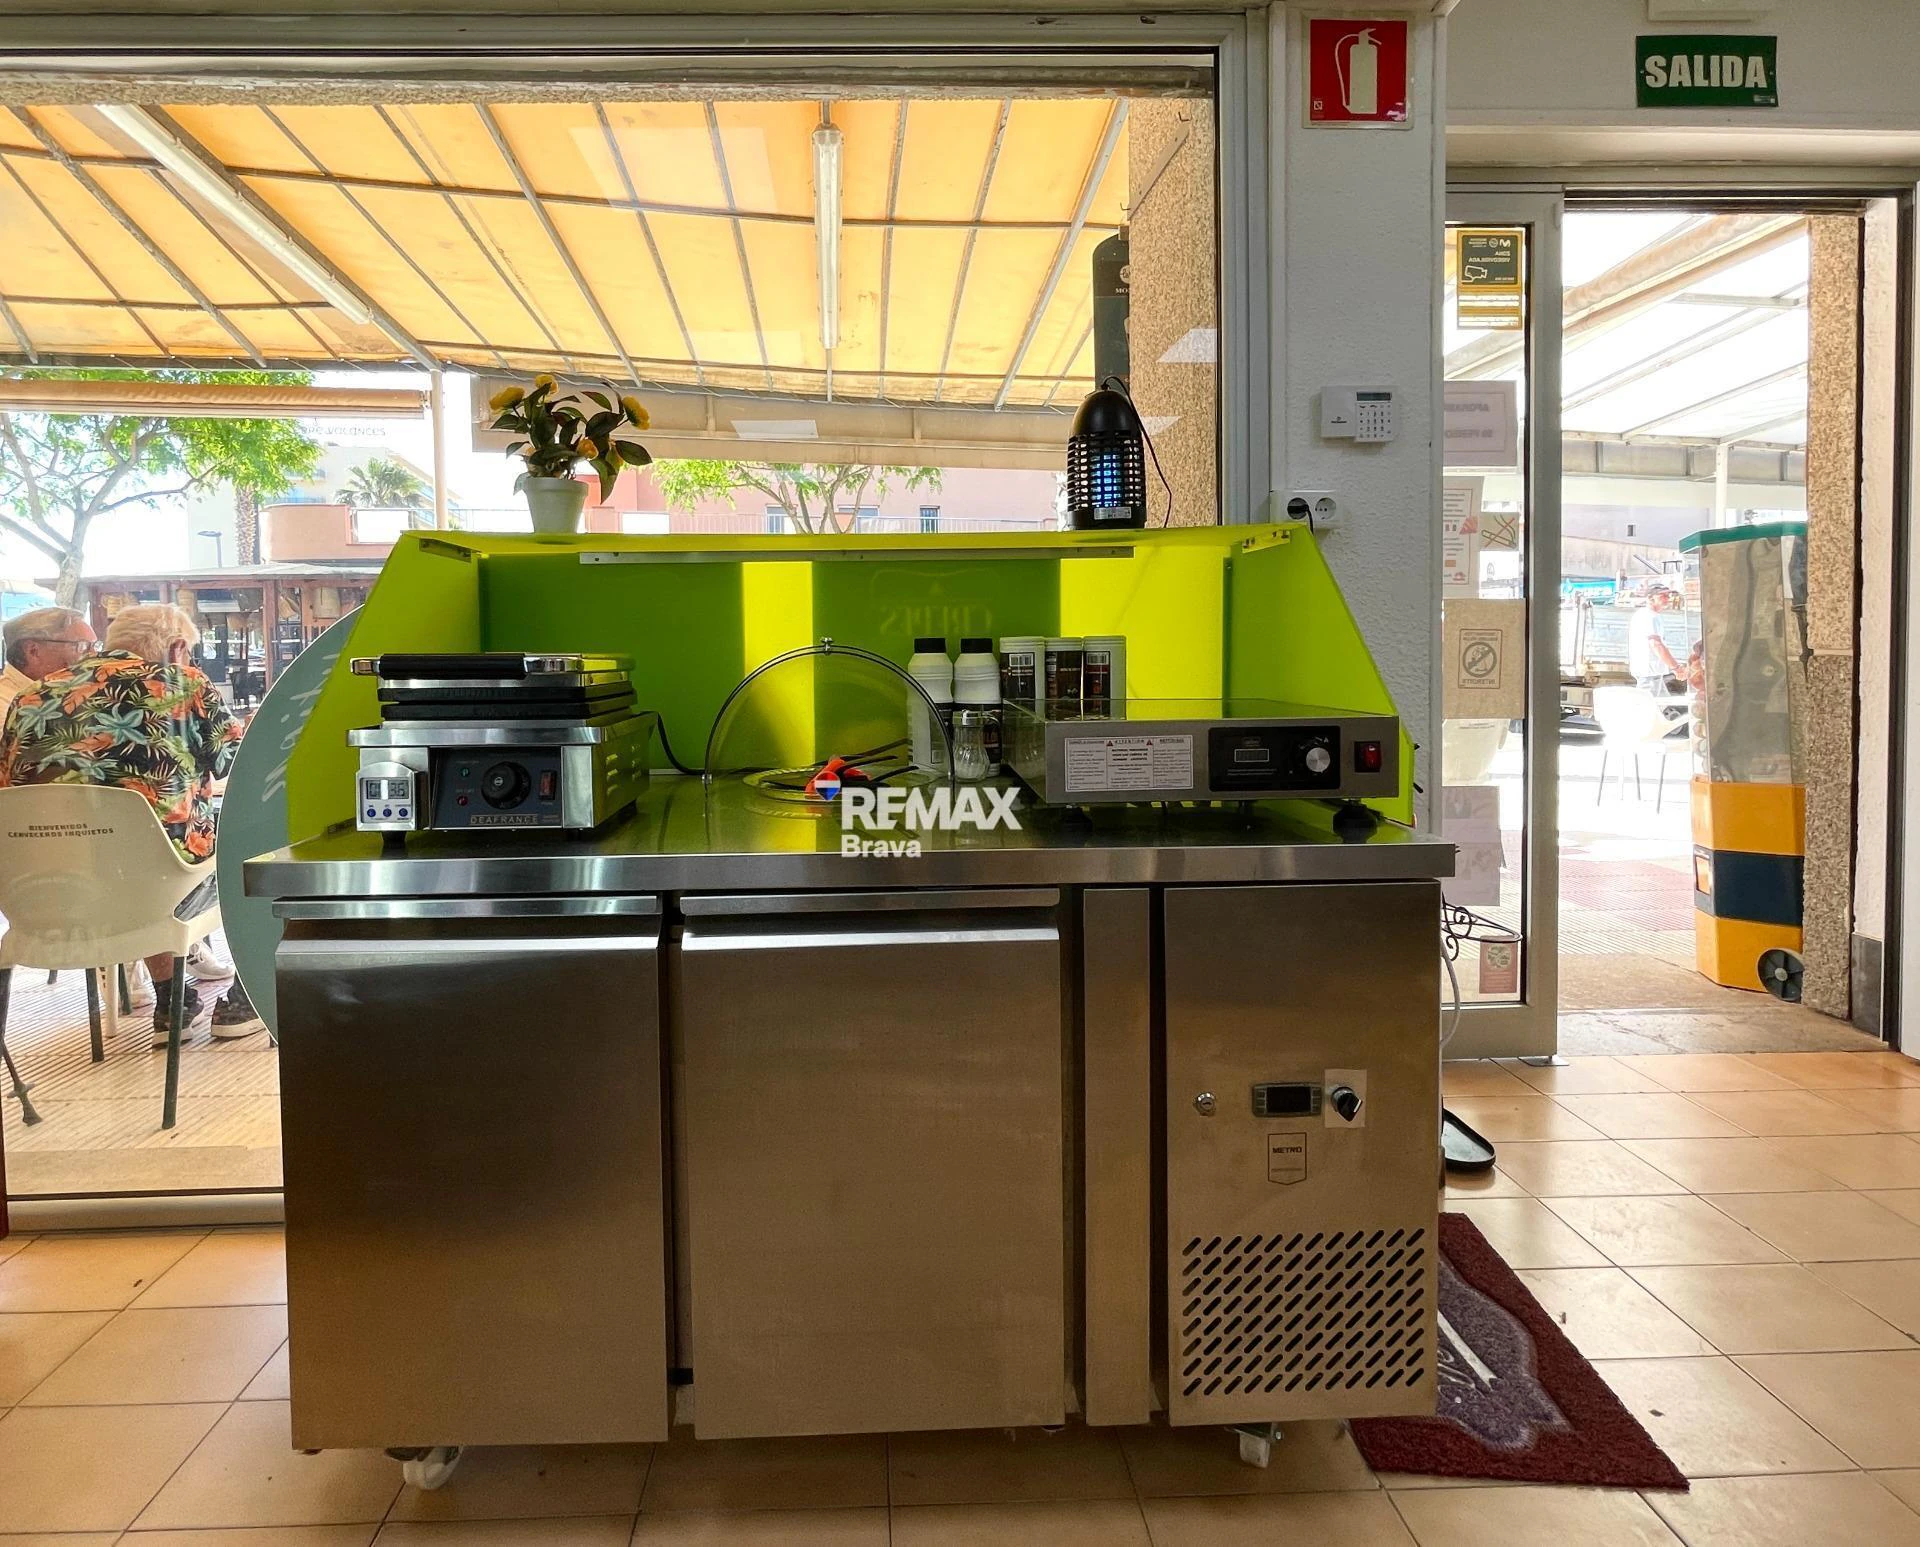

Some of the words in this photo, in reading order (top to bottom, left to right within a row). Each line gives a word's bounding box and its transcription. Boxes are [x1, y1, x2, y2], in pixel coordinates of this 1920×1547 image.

[1645, 54, 1768, 89] SALIDA
[470, 815, 538, 825] DEAFRANCE
[28, 823, 88, 831] BIENVENIDOS
[64, 828, 114, 838] INQUIETOS
[1272, 1145, 1303, 1154] METRO
